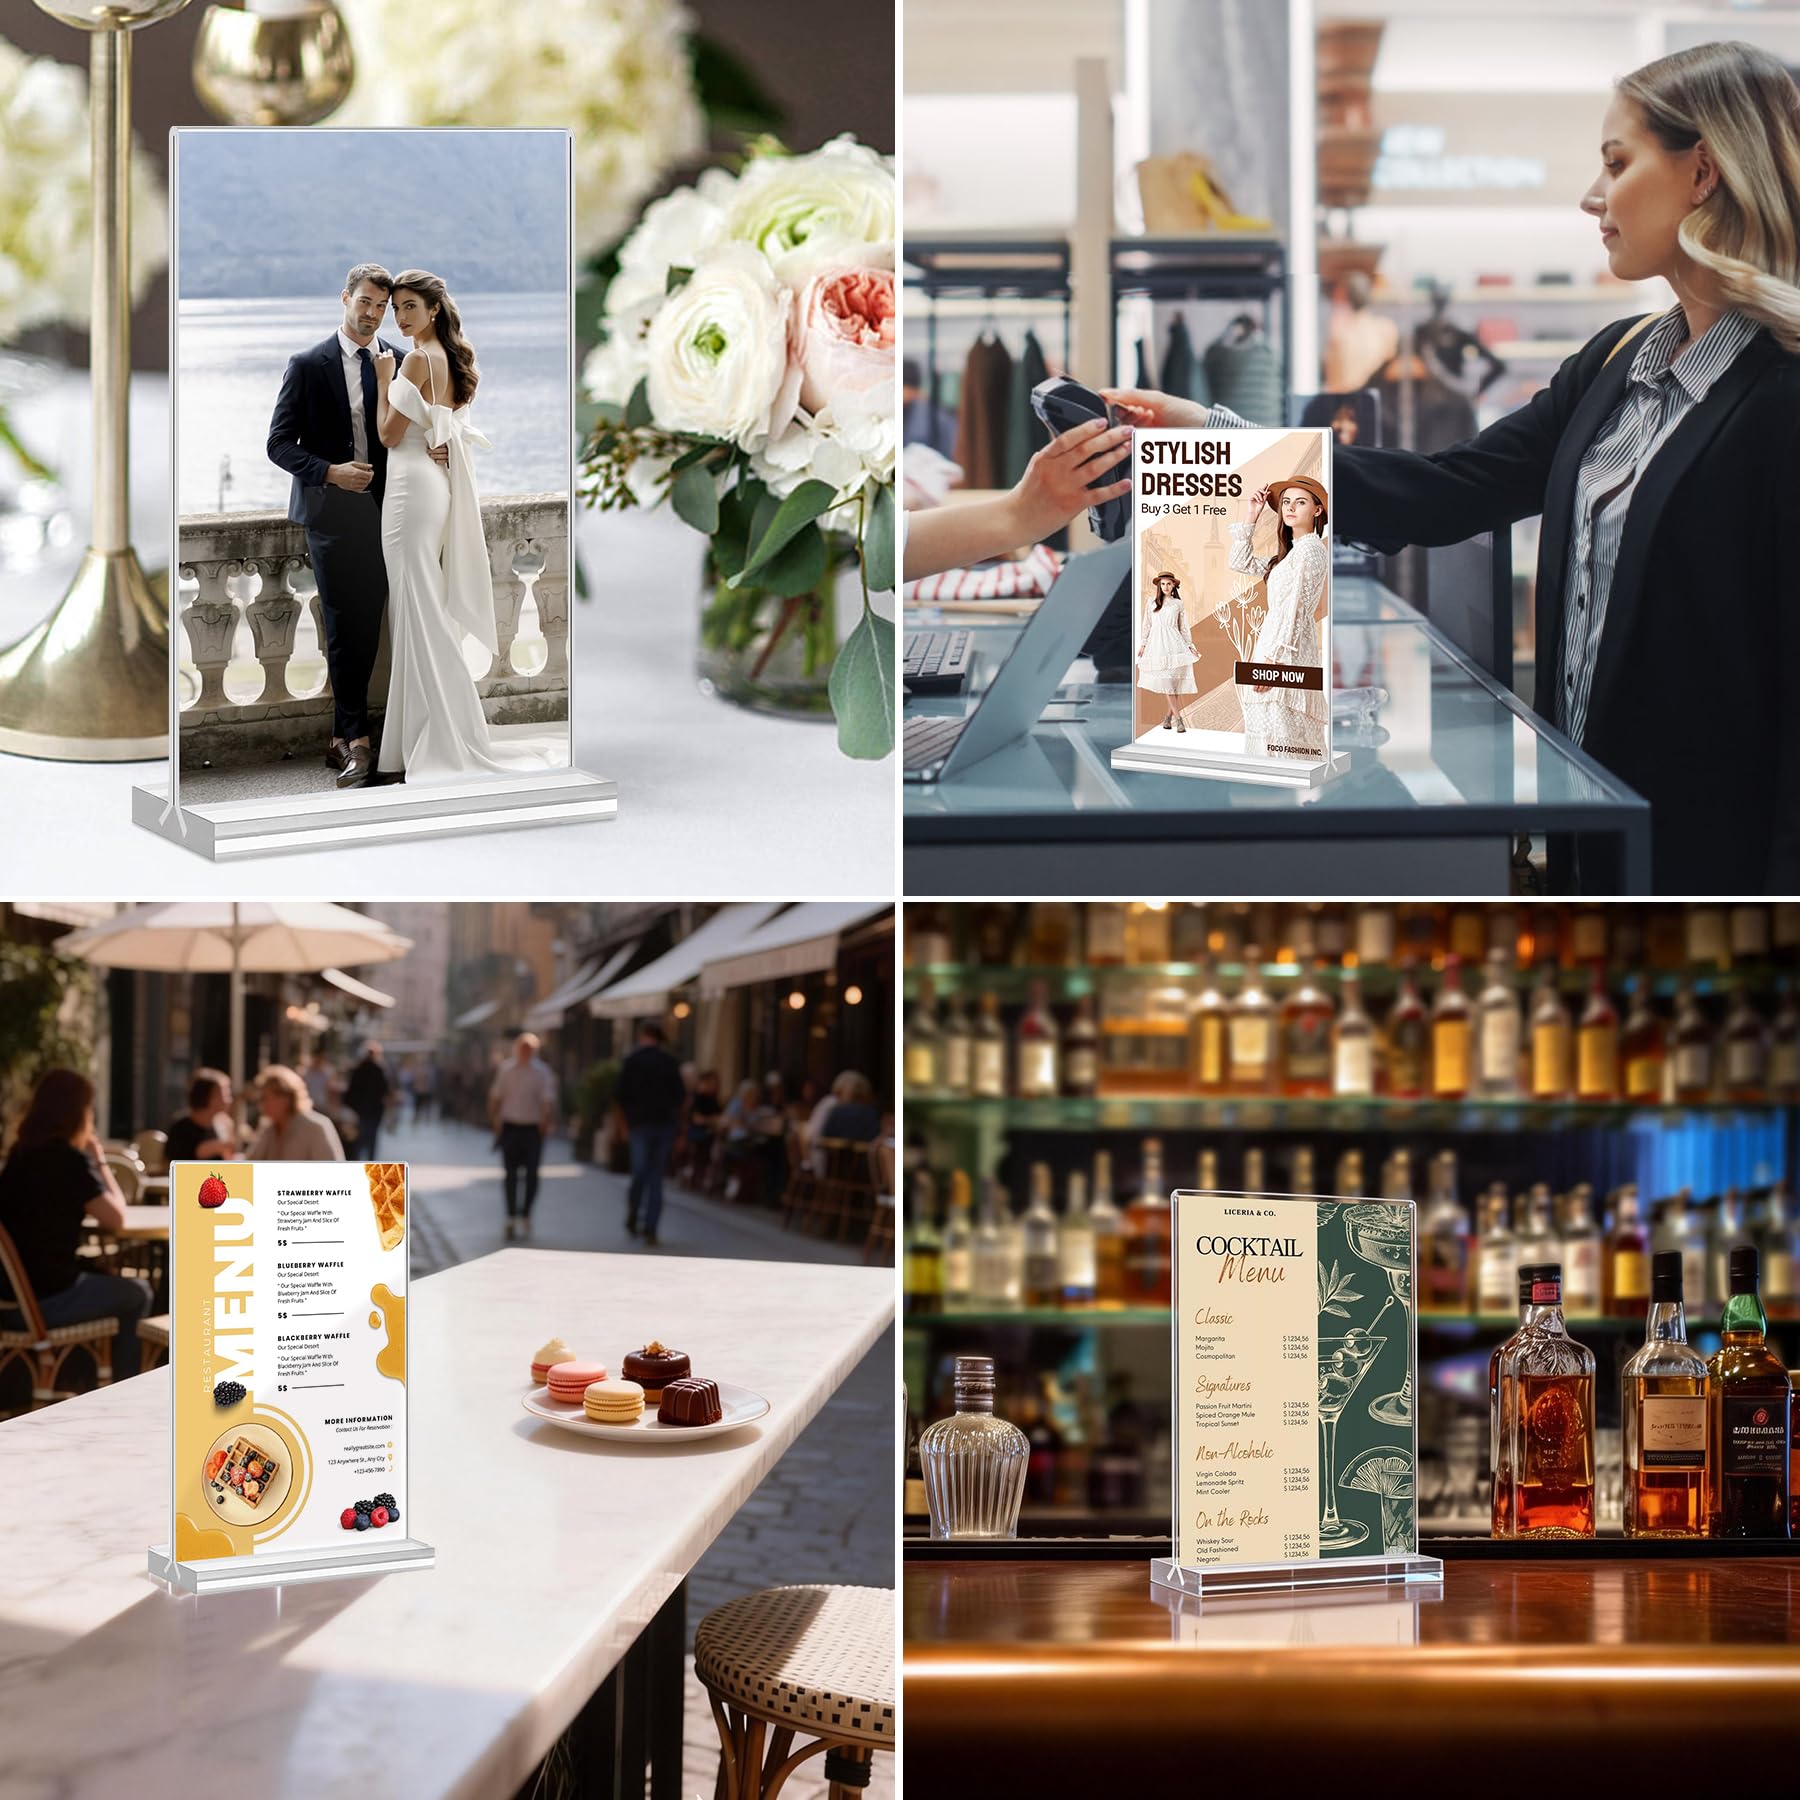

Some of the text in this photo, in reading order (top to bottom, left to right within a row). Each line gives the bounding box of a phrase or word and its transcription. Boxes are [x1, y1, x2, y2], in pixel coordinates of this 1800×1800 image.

[1141, 441, 1231, 465] STYLISH
[1141, 472, 1243, 497] DRESSES
[1141, 504, 1227, 517] Buy 3 Get 1 Free
[1252, 669, 1305, 683] SHOP NOW
[1267, 744, 1283, 752] FOCO
[1284, 745, 1309, 754] FASHION
[1196, 1235, 1304, 1257] COCKTAIL
[1218, 1253, 1286, 1284] Menu
[214, 1198, 254, 1392] MENU
[1194, 1307, 1234, 1325] Classic
[203, 1299, 211, 1393] RESTAURANT
[277, 1334, 322, 1342] BLACKBERRY
[1195, 1335, 1225, 1343] Margarita
[1195, 1344, 1214, 1352] Mojito
[1195, 1375, 1251, 1399] Signatures
[345, 1415, 393, 1423] INFORMATION
[1196, 1440, 1274, 1461] Non-Alcoholic
[1196, 1507, 1269, 1529] On the Rocks
[1197, 1556, 1220, 1564] Negroni
